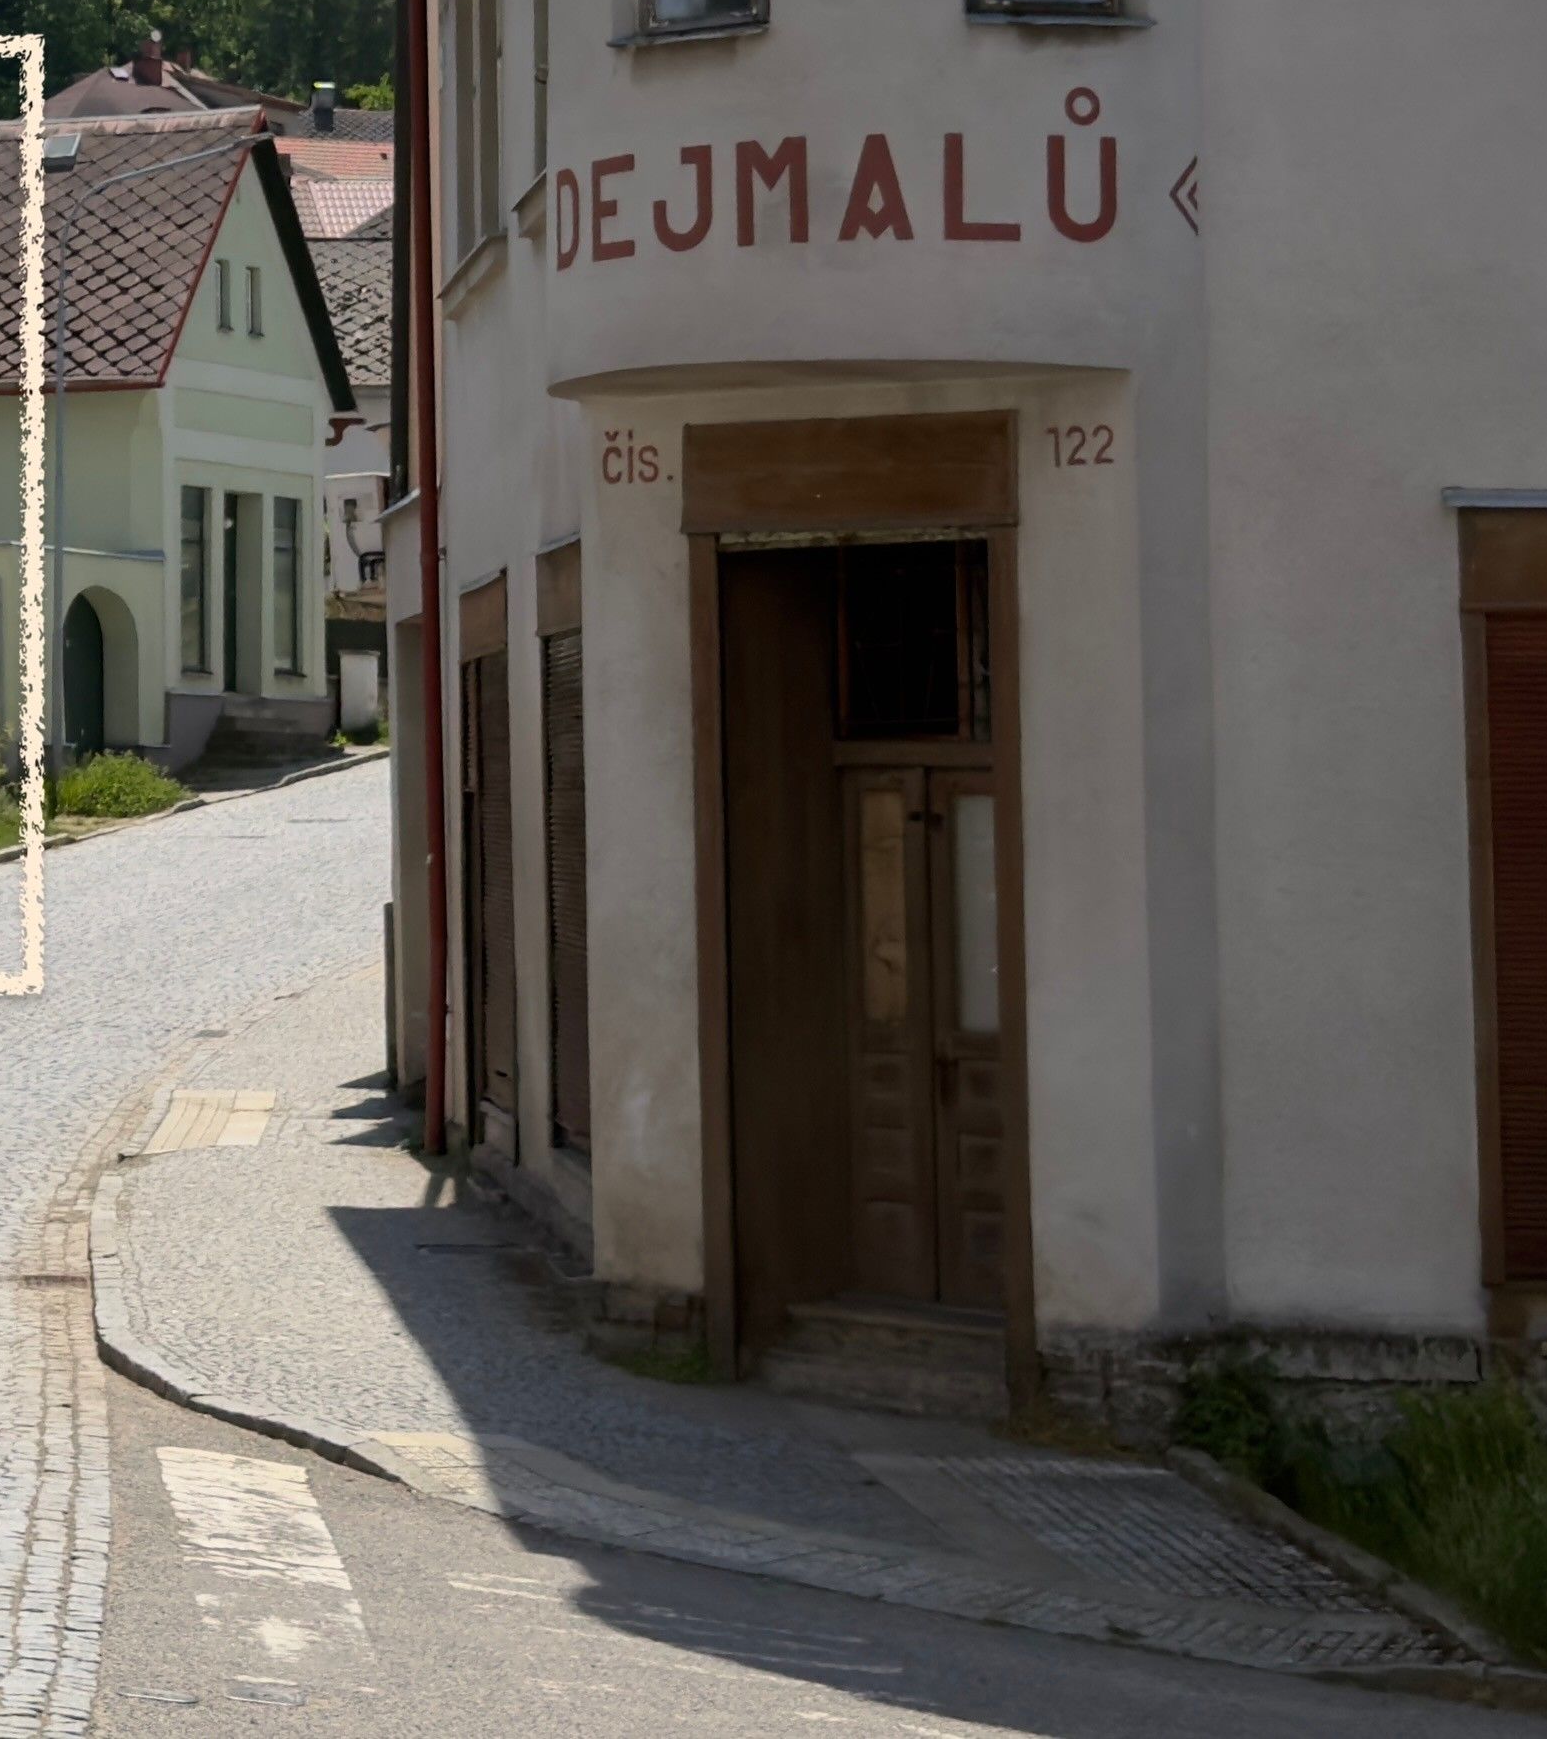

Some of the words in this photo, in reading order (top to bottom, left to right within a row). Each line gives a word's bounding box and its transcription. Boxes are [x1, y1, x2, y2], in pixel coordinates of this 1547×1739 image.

[555, 86, 1117, 272] DEJMALŮ
[602, 428, 674, 485] čís.
[1046, 424, 1116, 469] 122
